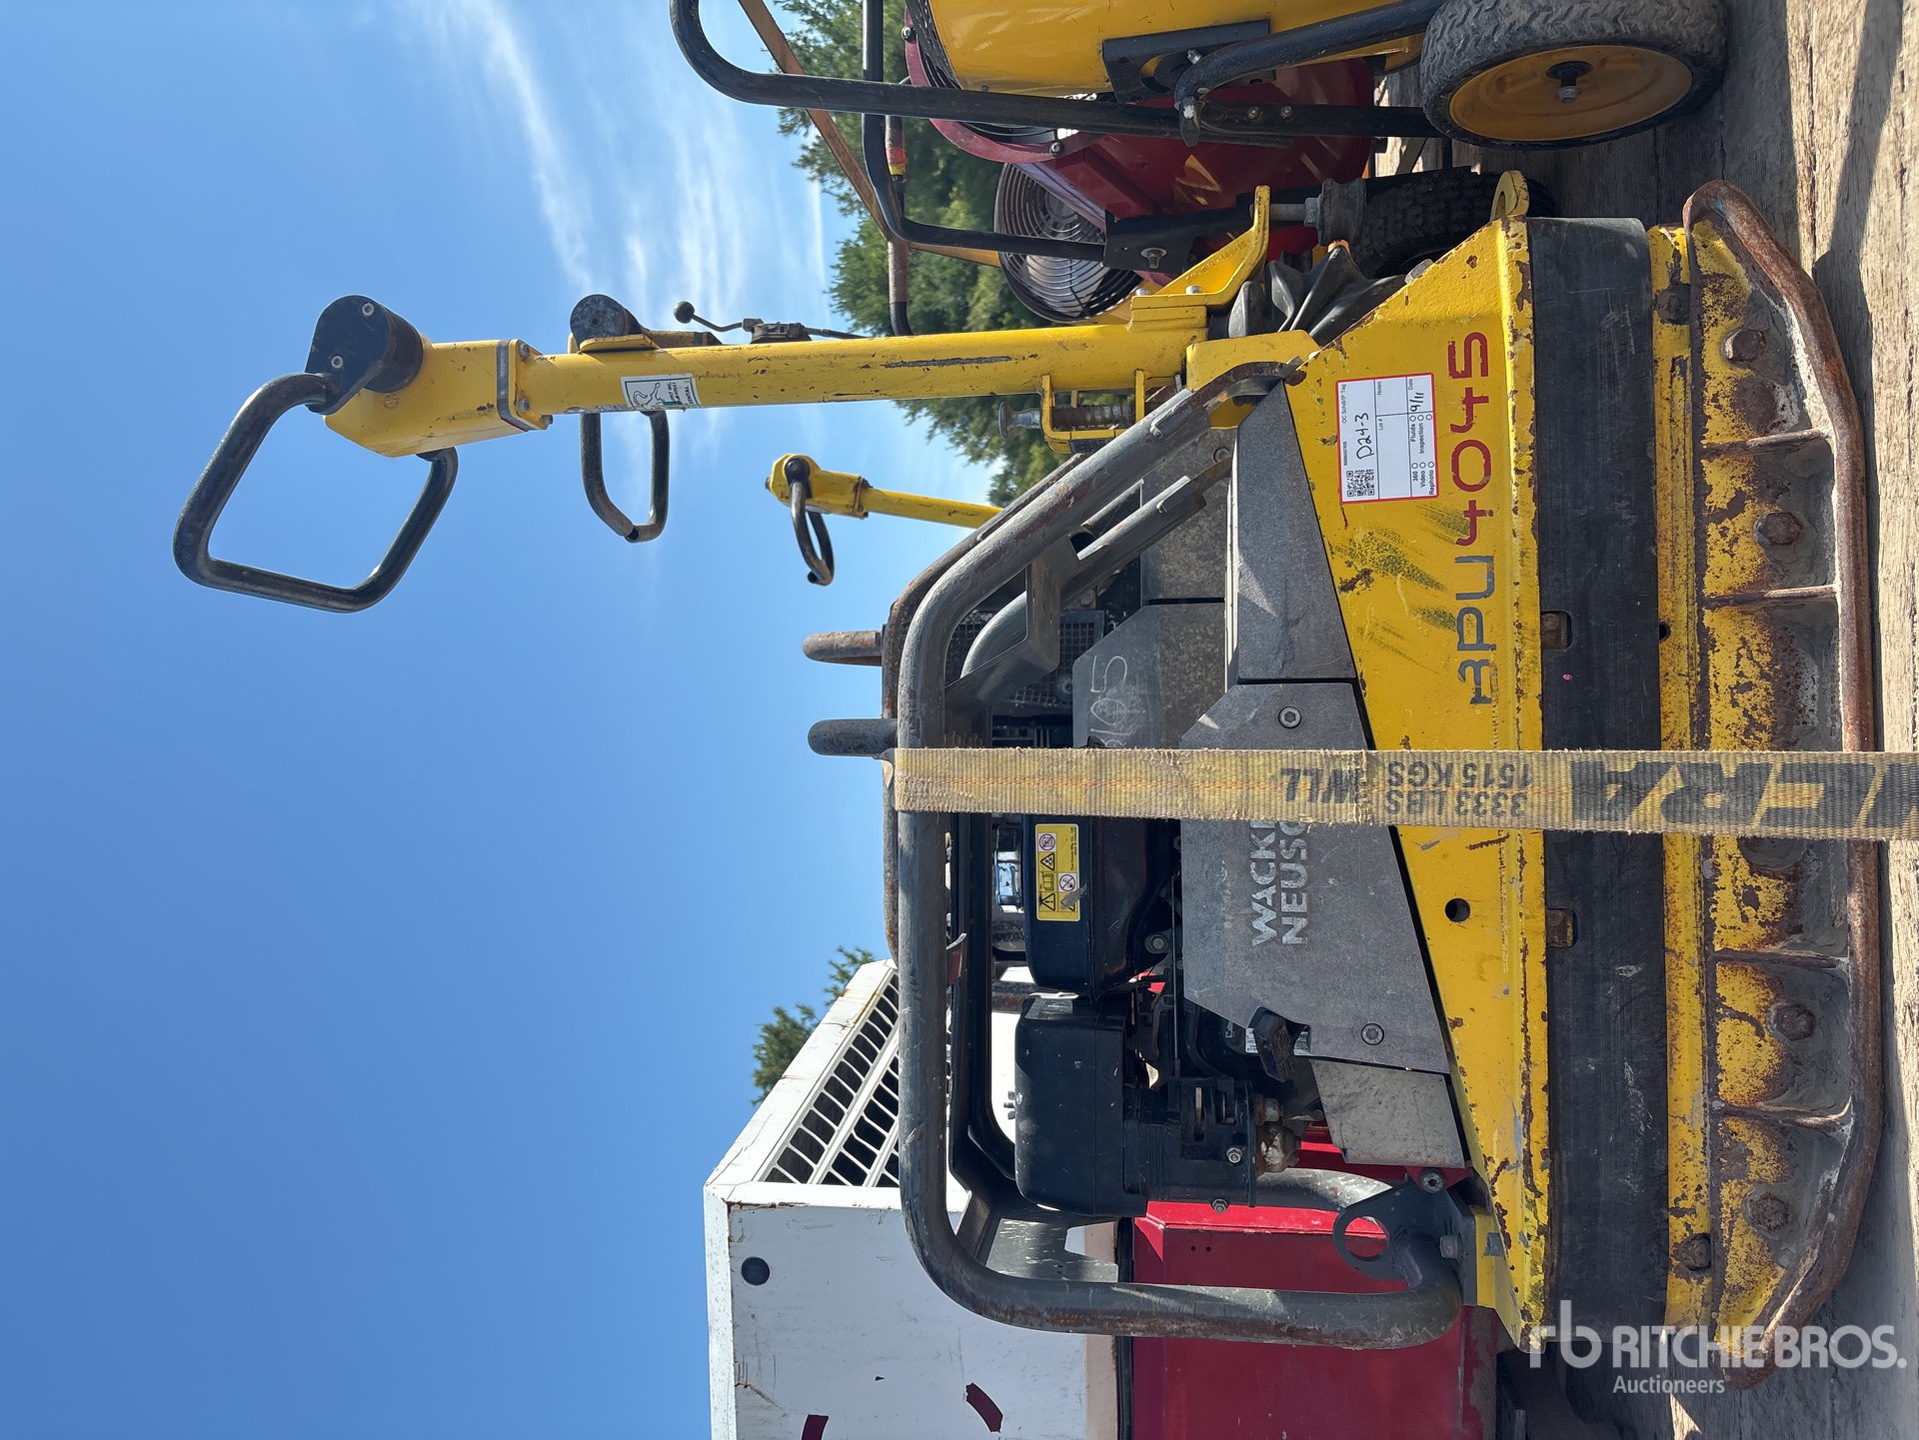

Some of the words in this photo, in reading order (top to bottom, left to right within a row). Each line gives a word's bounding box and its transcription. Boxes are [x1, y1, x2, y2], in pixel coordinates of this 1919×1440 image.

[1355, 412, 1374, 459] D24-3
[1387, 761, 1454, 788] KGS
[1462, 763, 1532, 790] 1515
[1384, 790, 1446, 816] LBS
[1455, 791, 1528, 818] 3333
